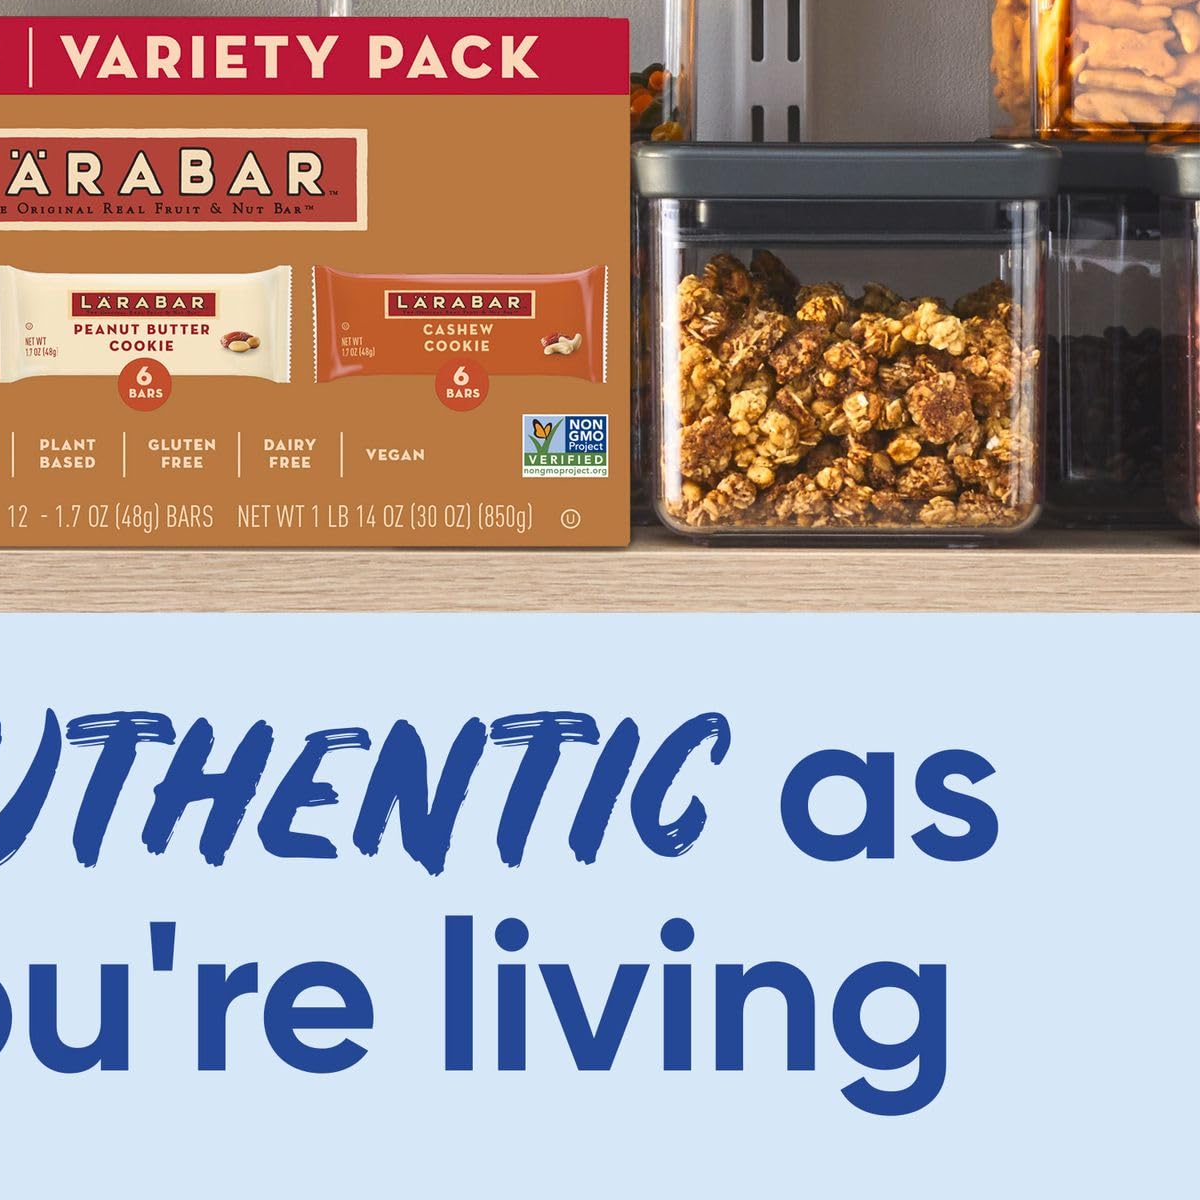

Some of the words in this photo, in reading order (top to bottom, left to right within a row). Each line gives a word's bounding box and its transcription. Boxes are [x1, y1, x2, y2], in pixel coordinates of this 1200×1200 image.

[60, 35, 339, 79] VARIETY
[369, 35, 539, 79] PACK
[210, 202, 222, 215] &
[73, 323, 140, 336] PEANUT
[147, 323, 210, 336] BUTTER
[423, 323, 494, 336] CASHEW
[25, 336, 35, 346] NET
[35, 336, 47, 346] WT
[109, 340, 174, 352] COOKIE
[341, 336, 351, 346] NET
[352, 336, 363, 346] WT
[424, 340, 490, 352] COOKIE
[135, 365, 153, 386] 6
[453, 365, 470, 386] 6
[128, 388, 163, 399] BARS
[446, 388, 481, 399] BARS
[569, 419, 603, 431] NON
[568, 430, 604, 442] GMO
[39, 438, 96, 451] PLANT
[148, 438, 216, 451] GLUTEN
[263, 438, 317, 451] DAIRY
[569, 442, 604, 453] Project
[365, 448, 425, 461] VEGAN
[528, 454, 604, 465] VERIFIED
[39, 456, 96, 469] BASED
[161, 456, 204, 469] FREE
[269, 456, 311, 469] FREE
[523, 467, 607, 476] nongmoproject.org
[7, 504, 28, 528] 12
[55, 504, 81, 528] 1.7
[88, 504, 109, 528] OZ
[115, 502, 159, 534] (48g)
[166, 504, 214, 528] BARS
[238, 504, 271, 528] NET
[276, 504, 305, 528] WT
[311, 504, 318, 528] 1
[328, 504, 349, 528] LB
[356, 504, 376, 528] 14
[383, 504, 404, 528] OZ
[410, 502, 437, 532] (30
[444, 502, 471, 532] OZ)
[478, 502, 533, 534] (850g)
